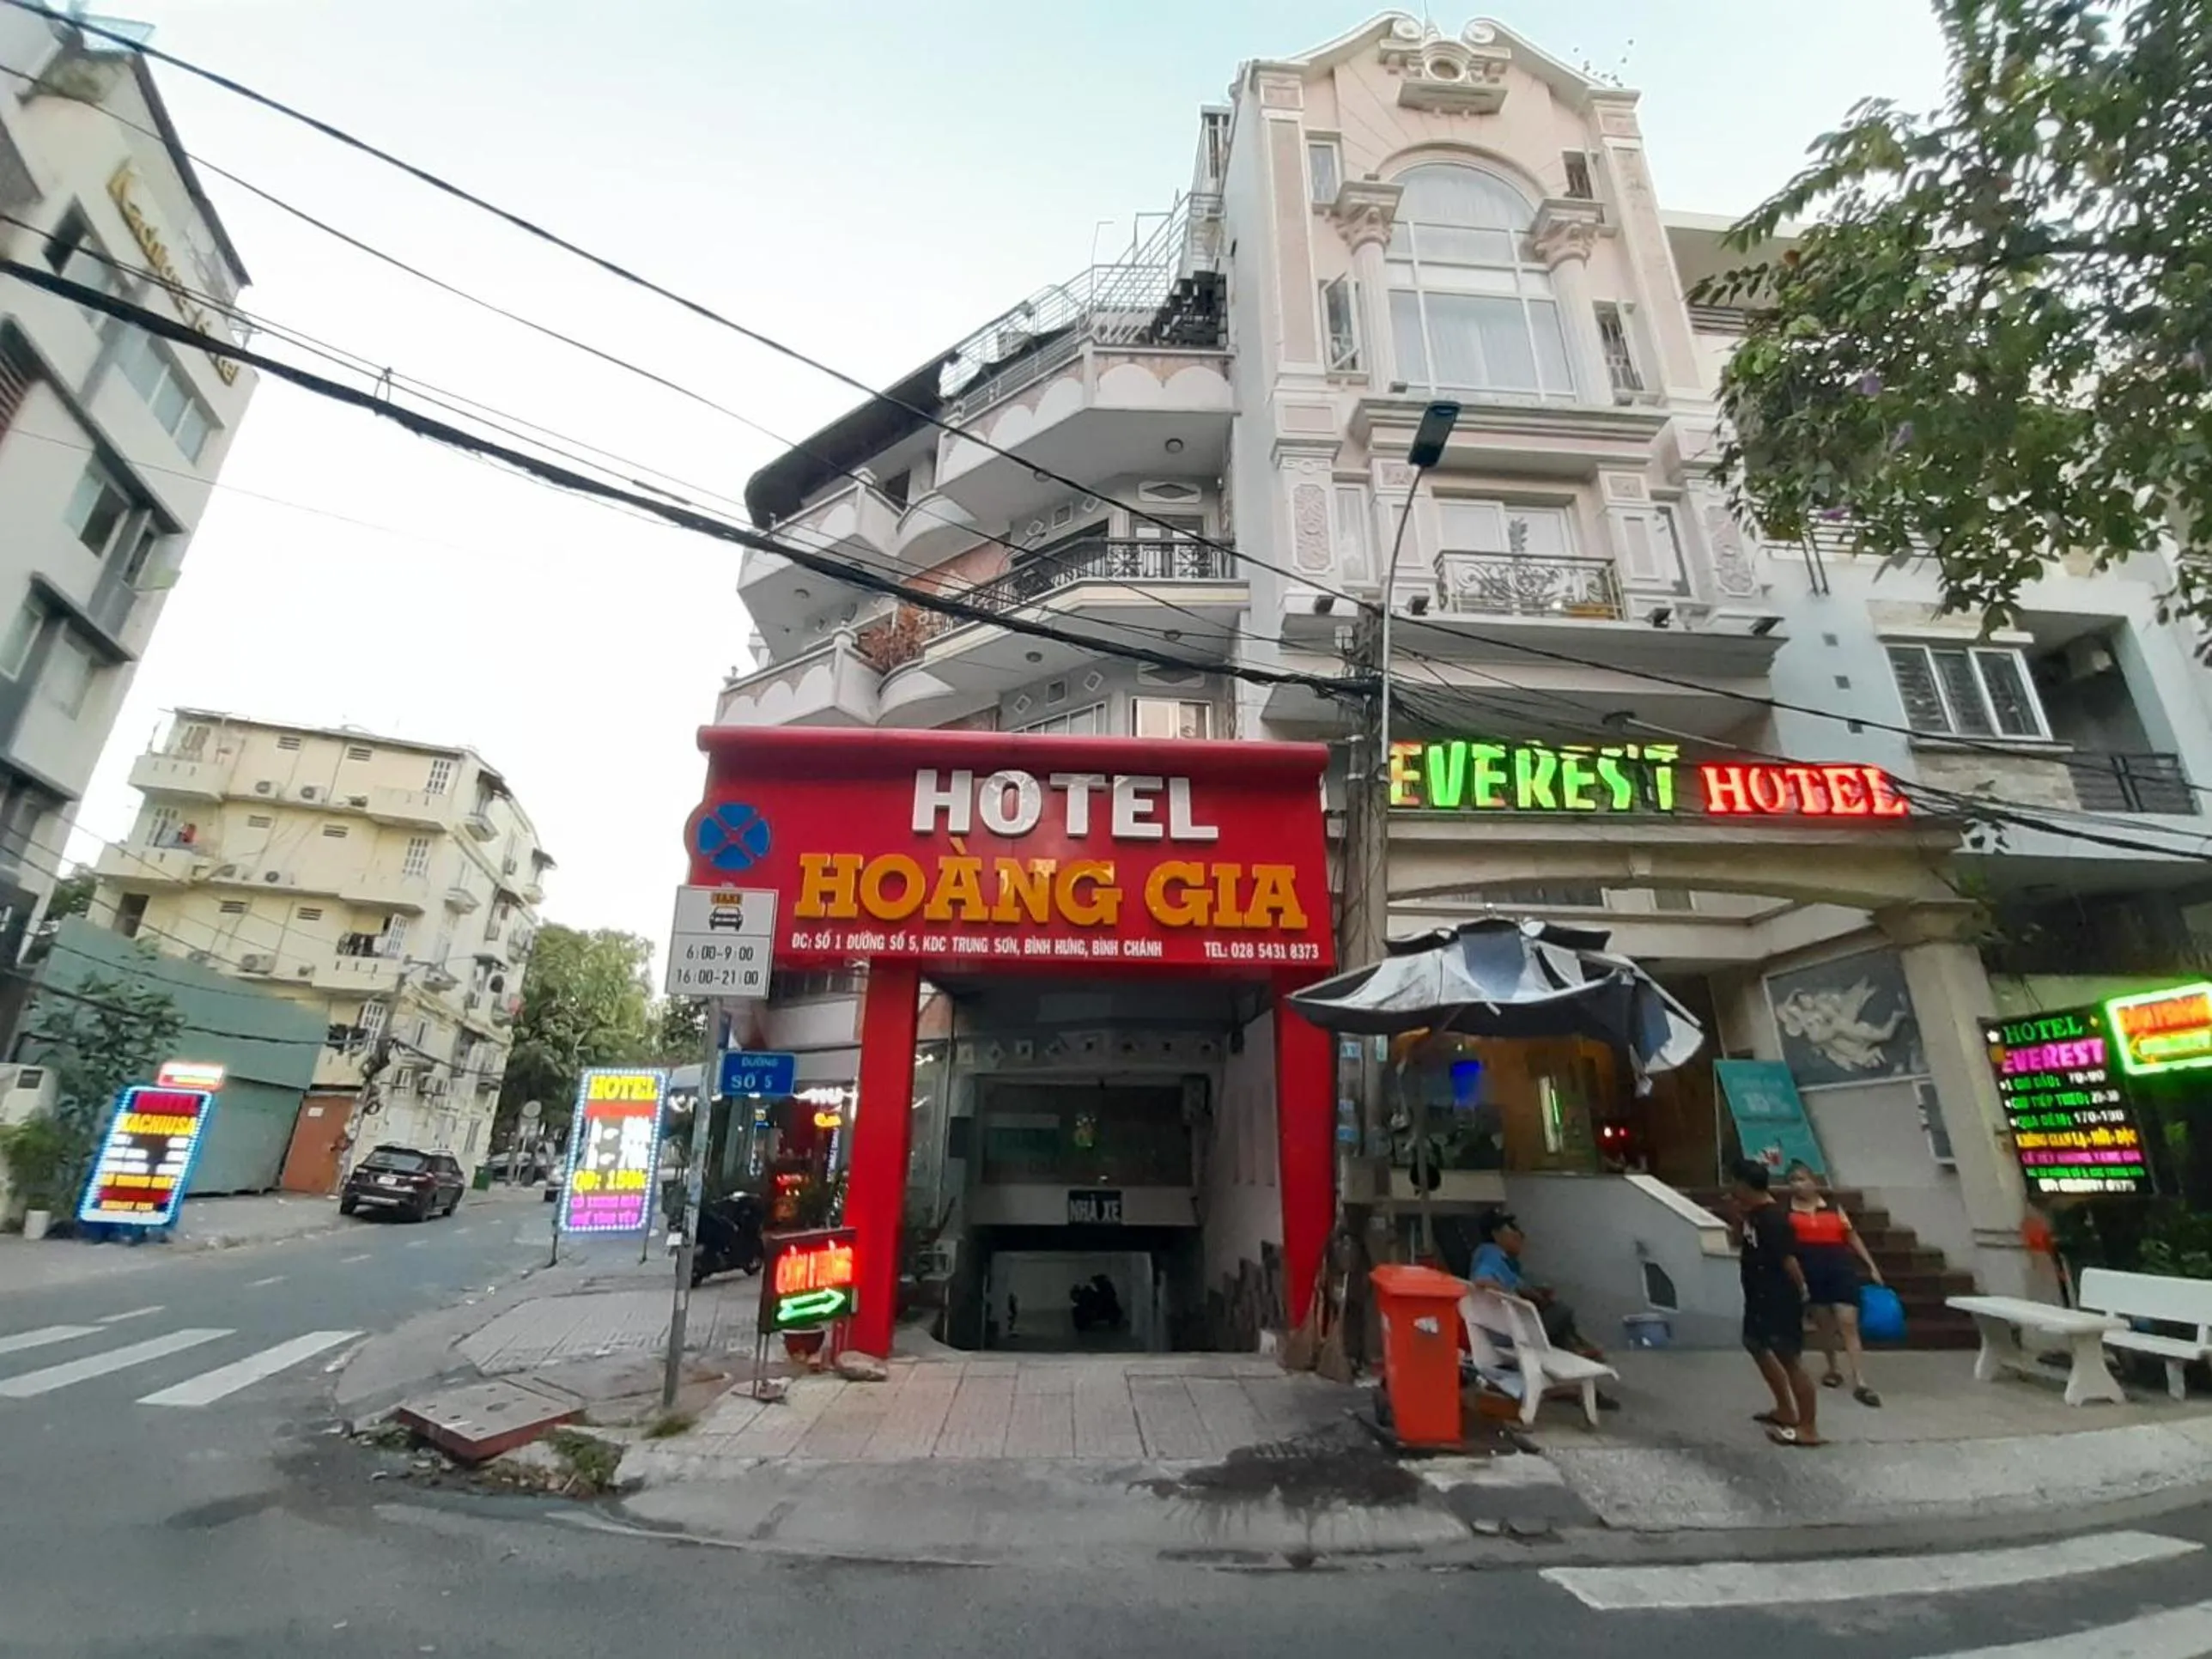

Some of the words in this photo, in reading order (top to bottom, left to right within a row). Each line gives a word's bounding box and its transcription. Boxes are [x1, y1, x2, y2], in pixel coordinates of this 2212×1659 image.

[1389, 738, 1680, 812] EVEREST
[1701, 763, 1910, 817] HOTEL
[912, 769, 1219, 842] HOTEL
[793, 836, 1124, 927] HOÀNG
[1145, 861, 1309, 930] GIA
[814, 929, 832, 951] SỐ
[835, 933, 841, 950] 1
[847, 930, 884, 951] ĐƯỜNG
[889, 930, 907, 951] SỐ
[908, 936, 920, 954] 5,
[923, 936, 946, 952] KDC
[952, 936, 988, 953] TRUNG
[994, 937, 1020, 957] SƠN,
[1024, 936, 1050, 956] BÌNH
[1092, 936, 1119, 957] BÌNH
[1123, 937, 1163, 957] CHÁNH
[1203, 941, 1228, 958] TEL:
[1231, 942, 1254, 959] 028
[1258, 942, 1286, 959] 5431
[1290, 943, 1319, 960] 8373
[2002, 1017, 2083, 1044] HOTEL
[2002, 1037, 2105, 1073] EVEREST
[588, 1076, 658, 1100] HOTEL
[763, 1074, 774, 1090] 5
[1070, 1194, 1098, 1223] NHÀ
[1102, 1200, 1121, 1223] XE
